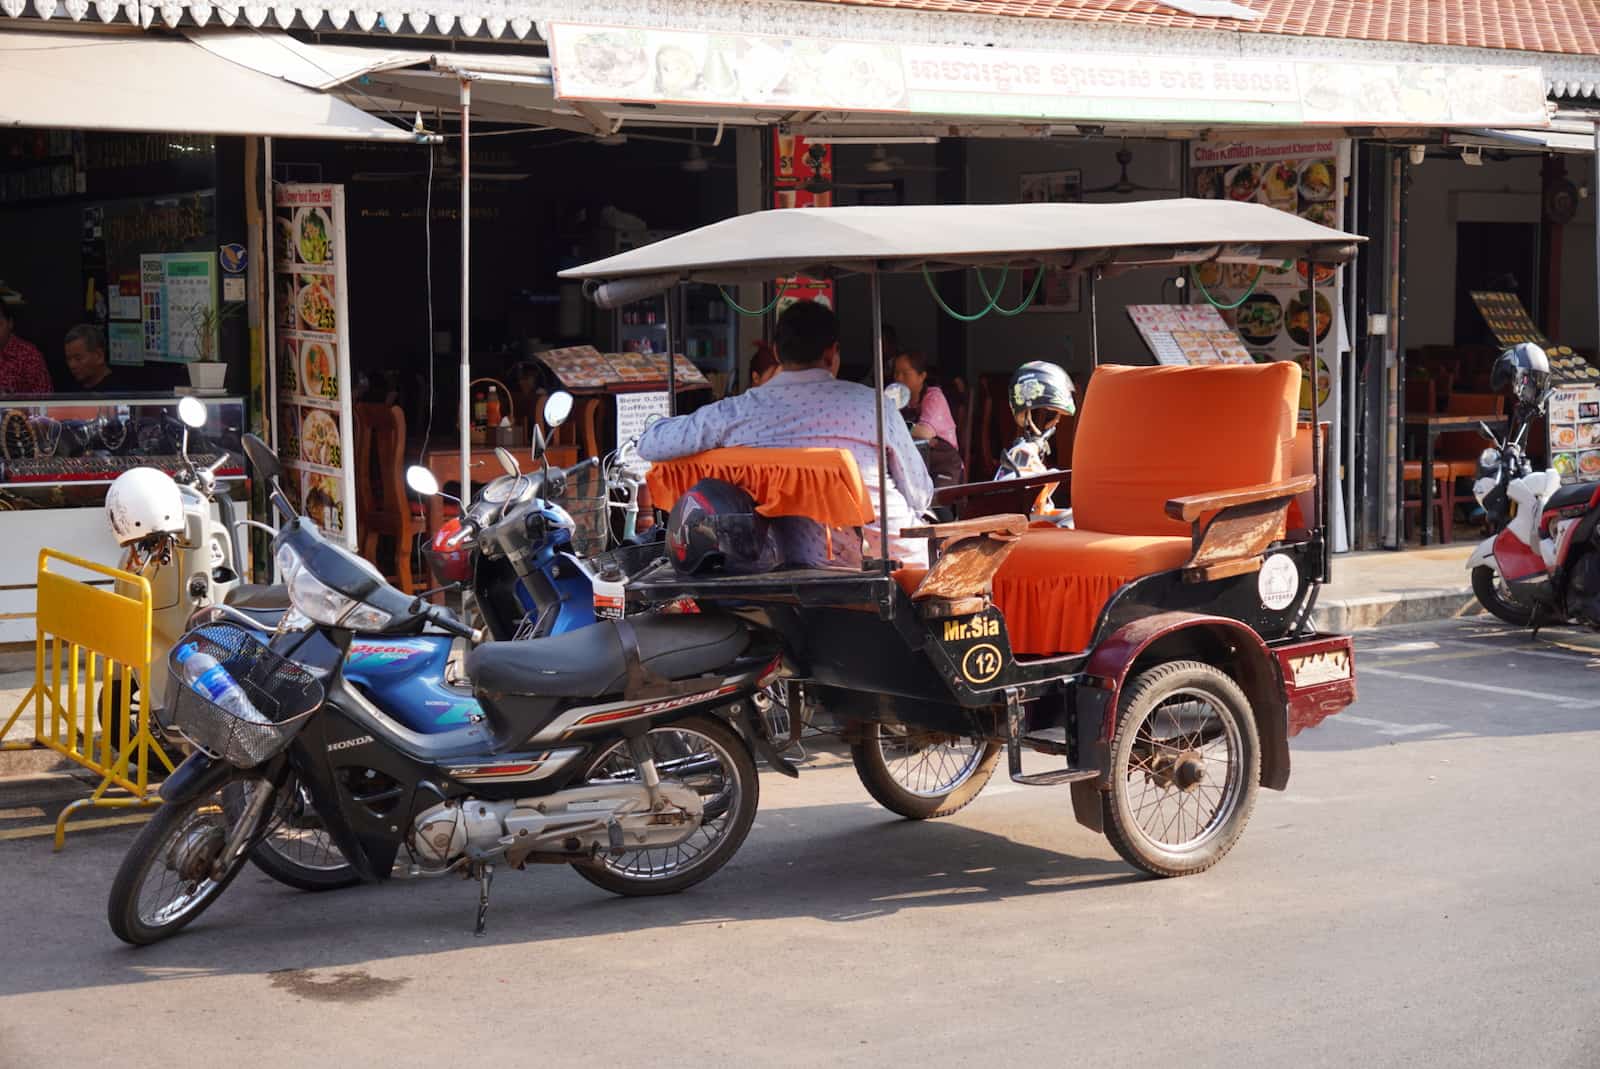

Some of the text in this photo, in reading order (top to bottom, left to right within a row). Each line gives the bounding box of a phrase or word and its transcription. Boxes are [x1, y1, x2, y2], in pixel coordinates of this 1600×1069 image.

[943, 615, 1000, 641] Mr.Sia
[975, 652, 995, 675] 12
[327, 735, 376, 752] HONDA
